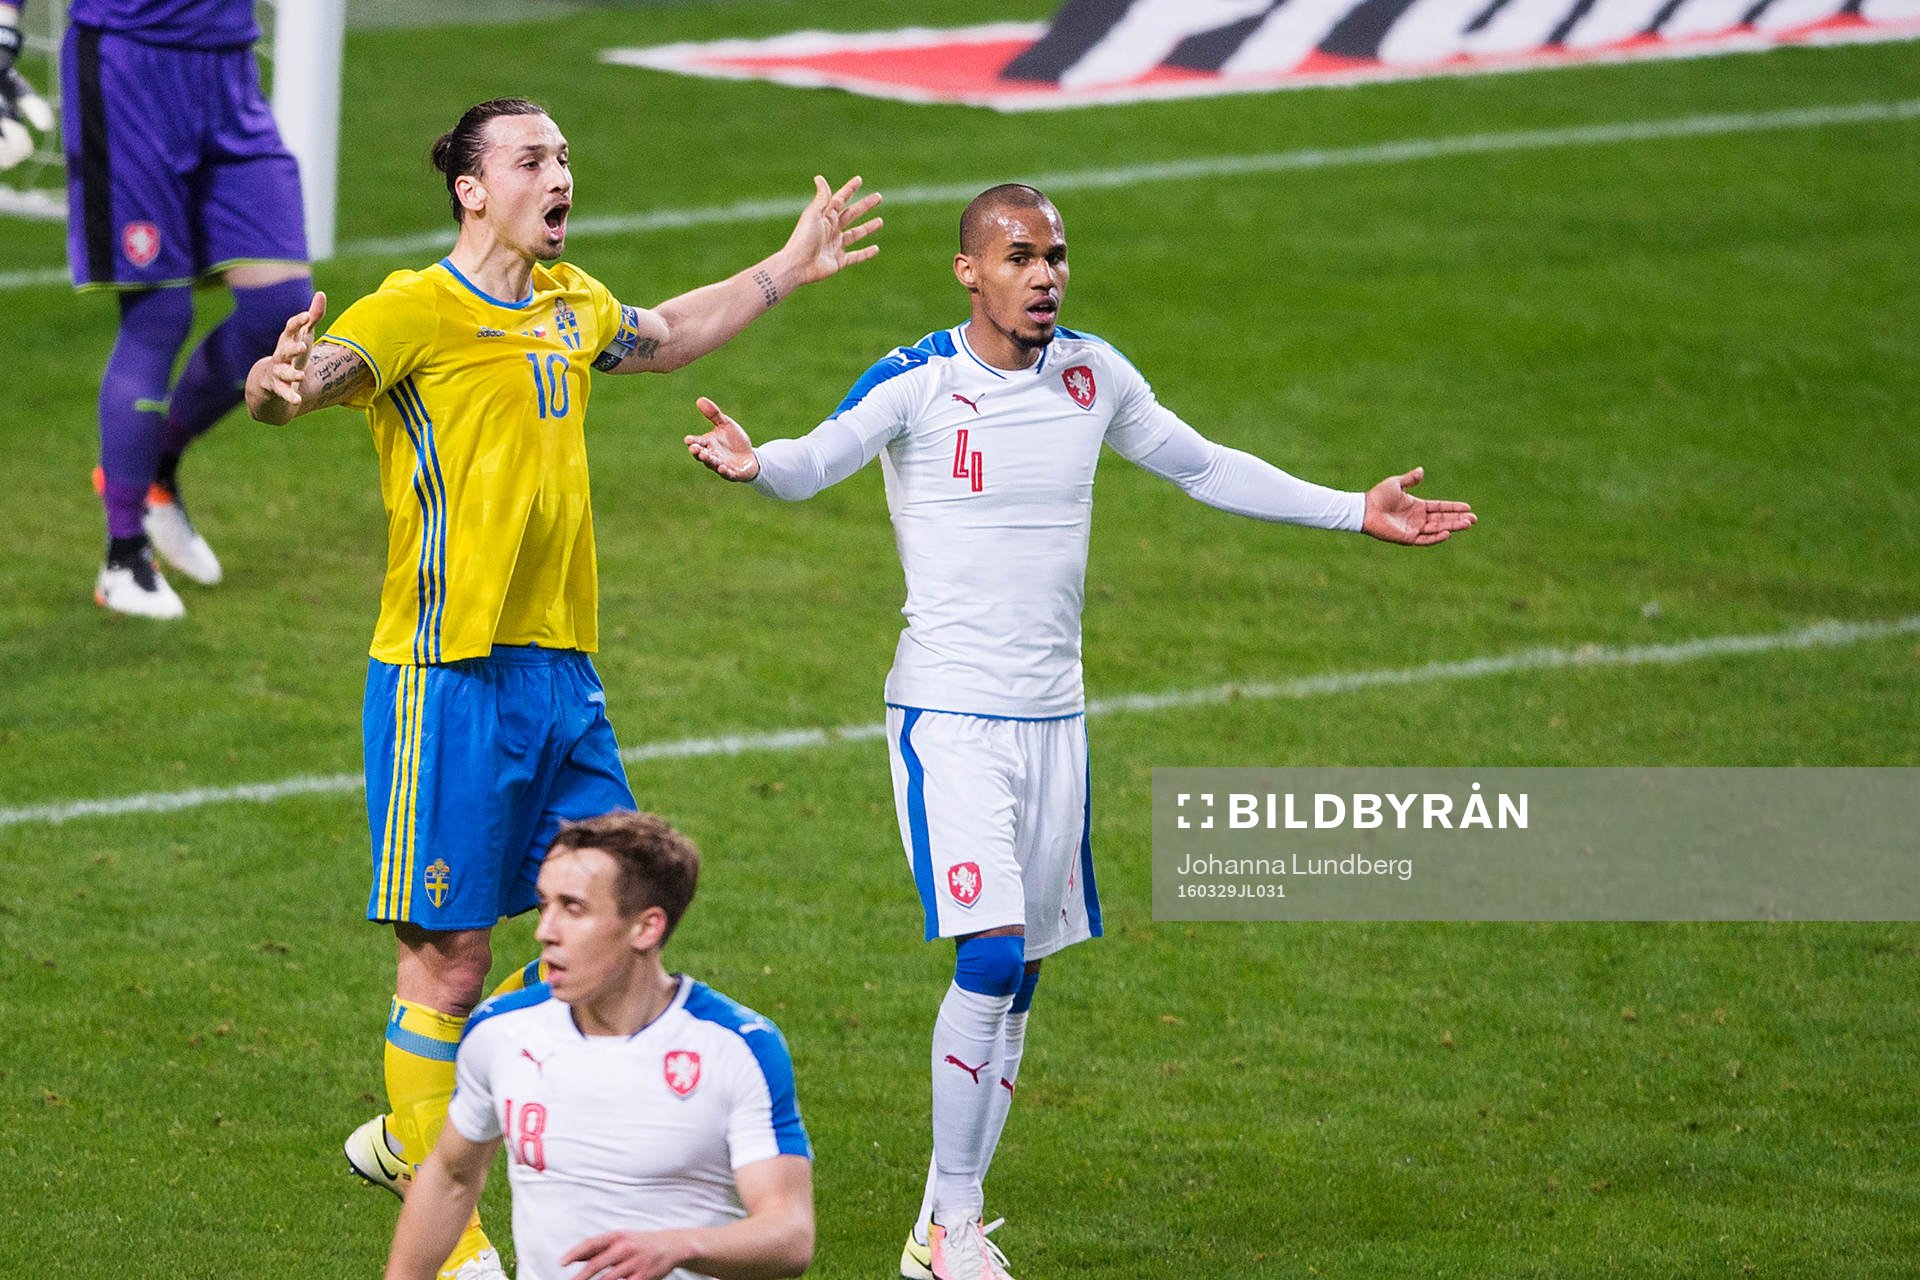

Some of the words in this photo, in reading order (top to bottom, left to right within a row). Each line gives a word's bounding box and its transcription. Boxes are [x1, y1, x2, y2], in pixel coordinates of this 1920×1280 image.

[526, 352, 570, 419] 10
[952, 428, 983, 492] 4
[504, 1098, 547, 1172] 18
